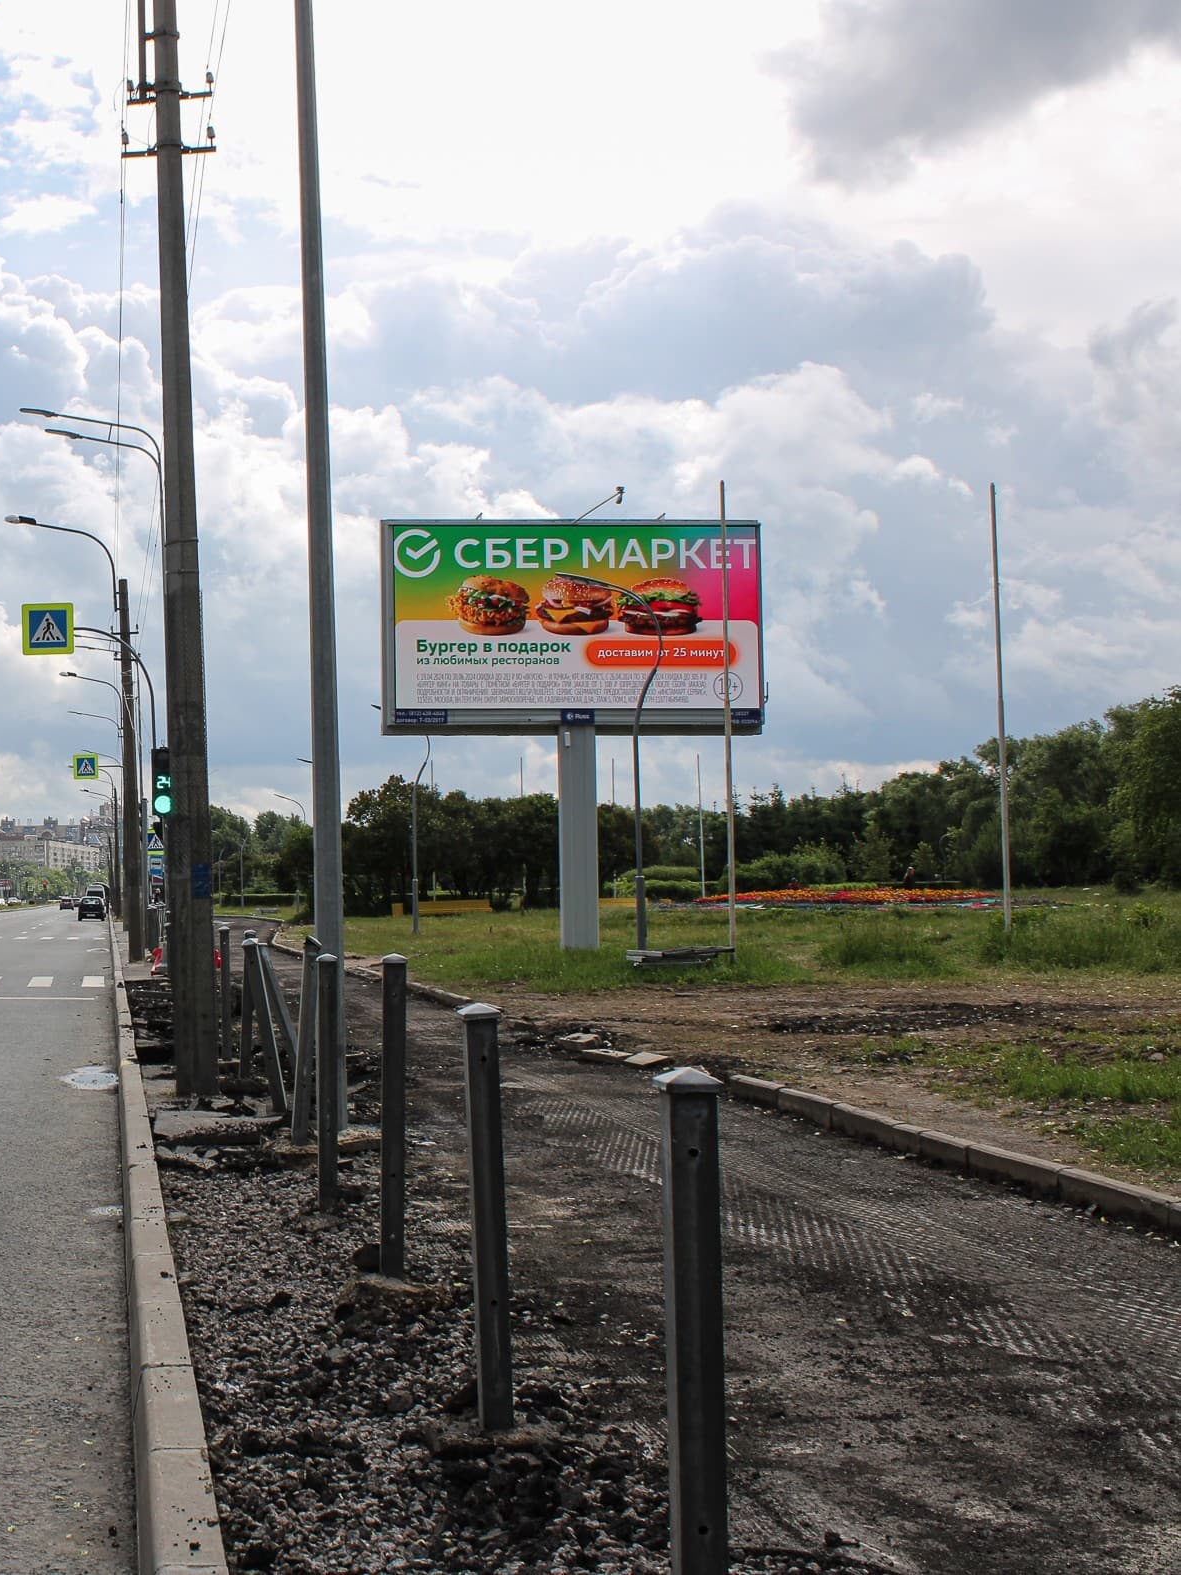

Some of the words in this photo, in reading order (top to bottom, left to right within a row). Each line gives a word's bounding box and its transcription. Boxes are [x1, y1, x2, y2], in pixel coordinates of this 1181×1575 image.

[453, 538, 569, 570] СБЕР
[582, 538, 756, 570] МАРКЕТ
[416, 639, 478, 656] Бургер
[483, 643, 492, 653] в
[497, 643, 572, 656] подарок
[597, 649, 654, 659] доставим
[672, 647, 687, 658] 25
[690, 649, 725, 661] минут
[416, 656, 430, 665] из
[433, 655, 488, 665] любимых
[491, 656, 560, 667] ресторанов
